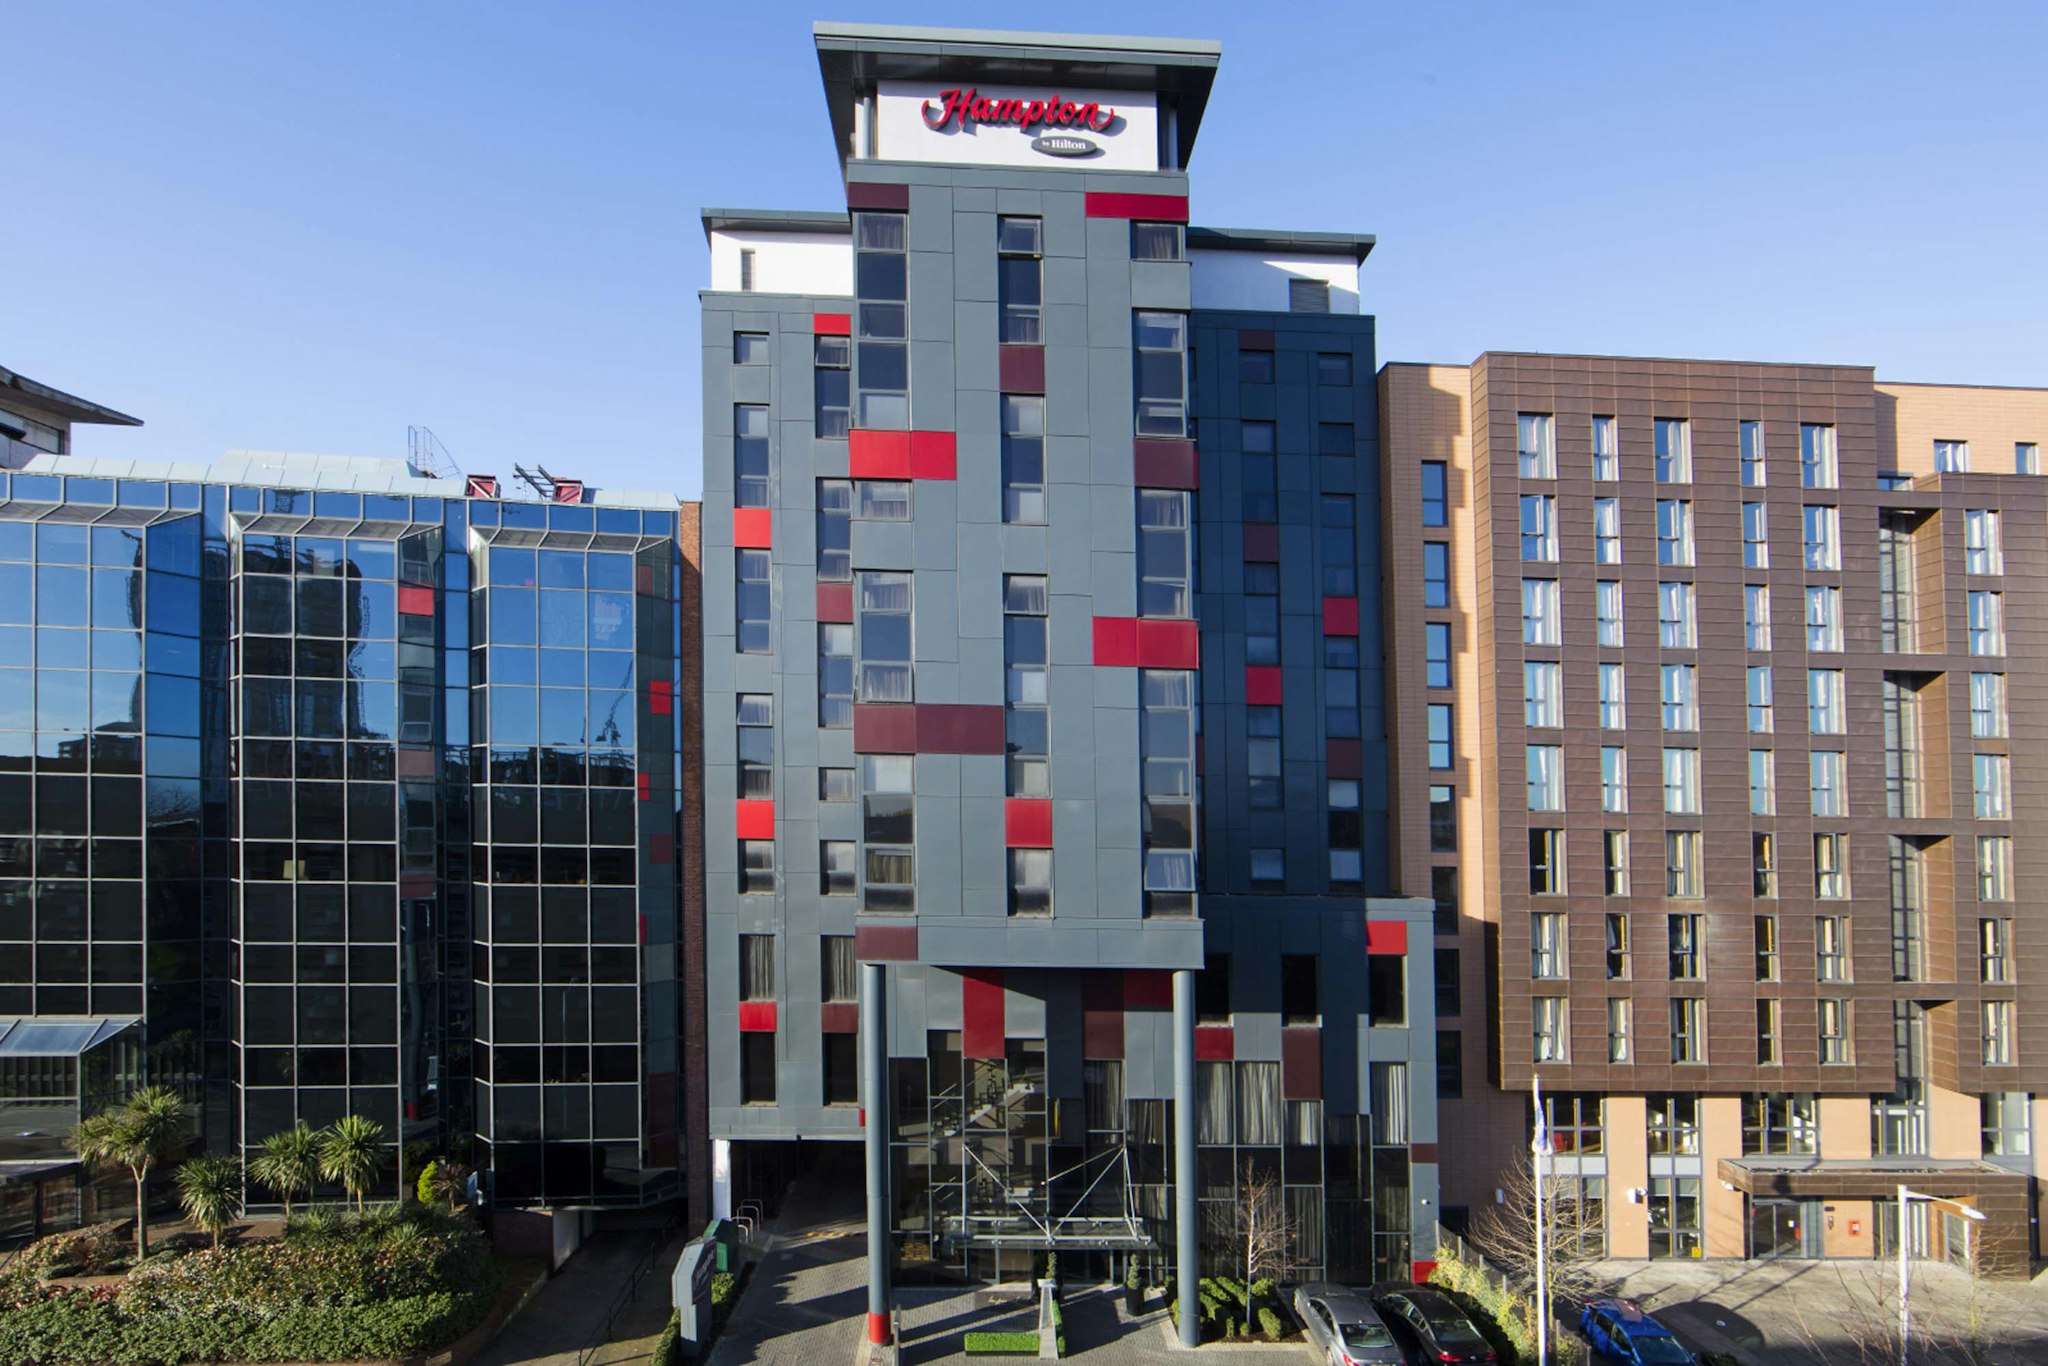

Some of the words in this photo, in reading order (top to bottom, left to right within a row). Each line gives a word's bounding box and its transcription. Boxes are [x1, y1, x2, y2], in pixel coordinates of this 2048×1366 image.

[922, 88, 1115, 132] Hampton
[1042, 140, 1050, 148] by
[1051, 139, 1086, 149] Hilton
